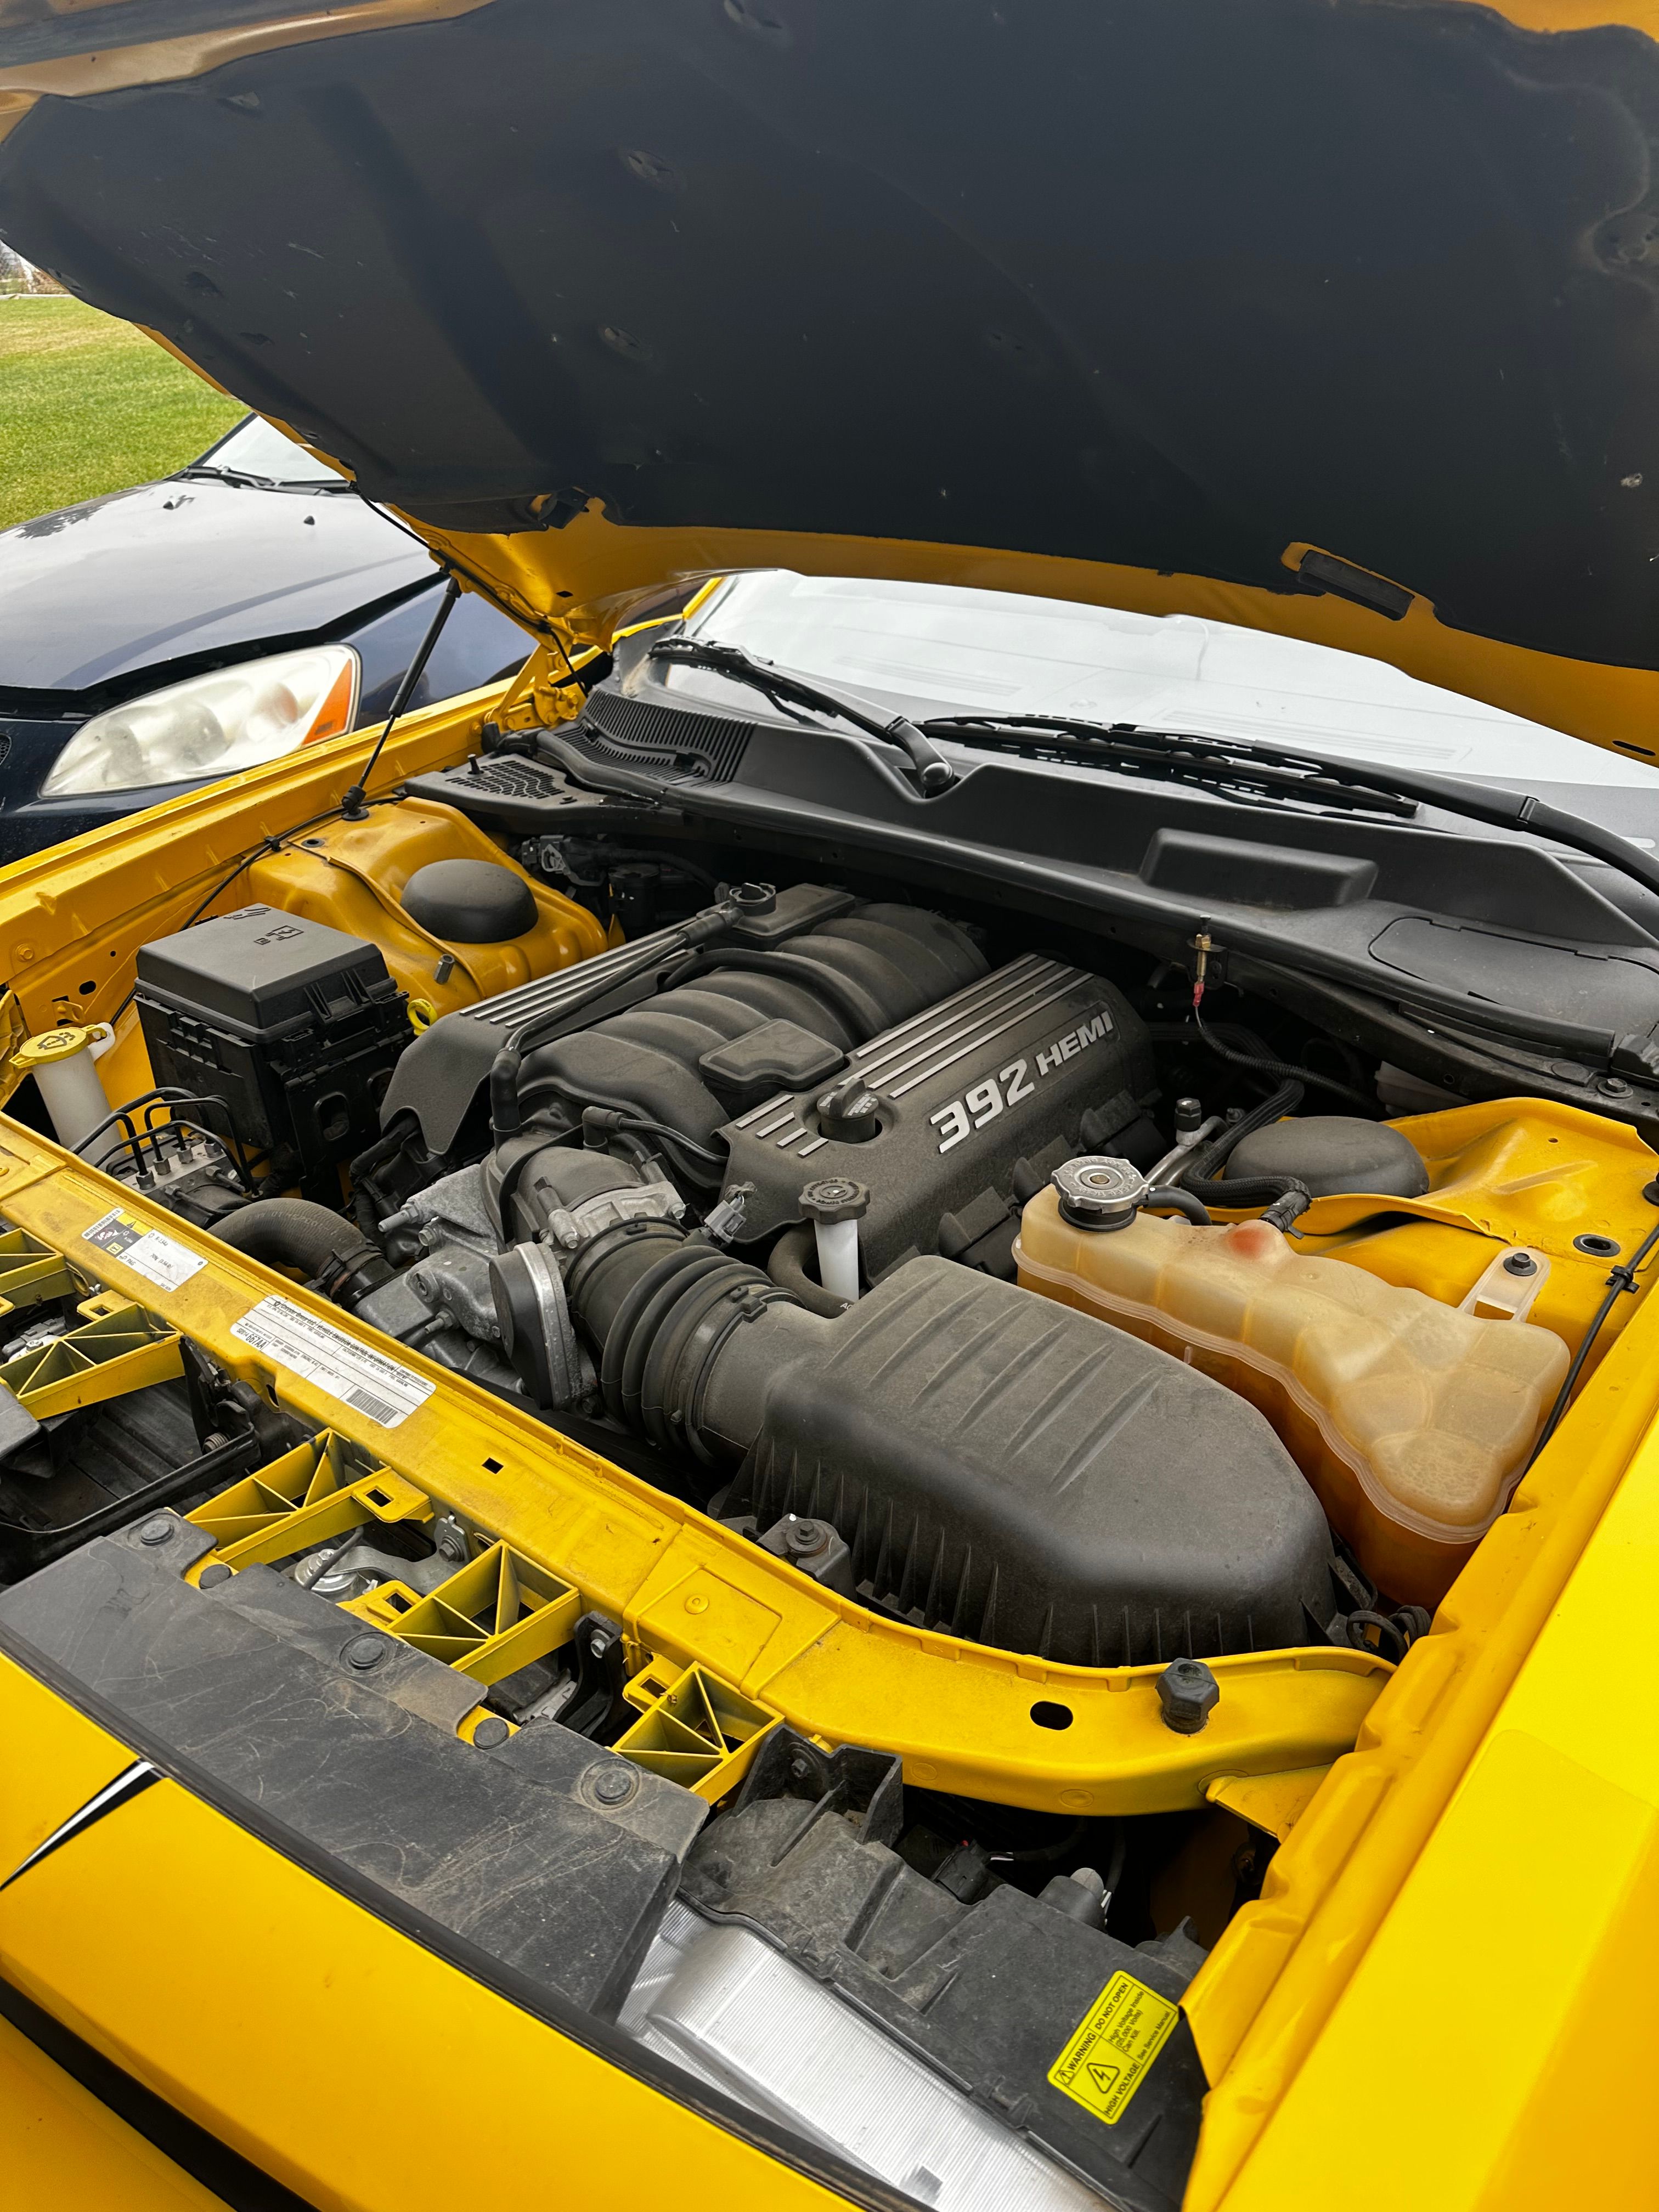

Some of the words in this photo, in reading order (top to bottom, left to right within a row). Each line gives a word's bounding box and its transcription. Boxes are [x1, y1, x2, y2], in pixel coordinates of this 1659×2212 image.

[930, 1059, 1035, 1154] 392
[1035, 1011, 1114, 1076] HEMI
[246, 1333, 267, 1349] 667AA
[350, 1344, 368, 1357] CONTROL
[367, 1354, 396, 1371] INFORMATION
[1067, 2032, 1097, 2070] WARNING
[1094, 2018, 1105, 2030] DO
[1103, 2002, 1116, 2018] NOT
[1112, 1982, 1128, 2002] OPEN
[1108, 2029, 1121, 2043] High
[1117, 2008, 1133, 2028] Voltage
[1130, 1991, 1144, 2008] Inside
[1128, 2009, 1144, 2025] Volts)
[1123, 2040, 1134, 2052] Can
[1137, 2049, 1147, 2060] See
[1144, 2030, 1159, 2049] Service
[1103, 2095, 1120, 2115] HIGH
[1116, 2062, 1141, 2095] VOLTAGE
